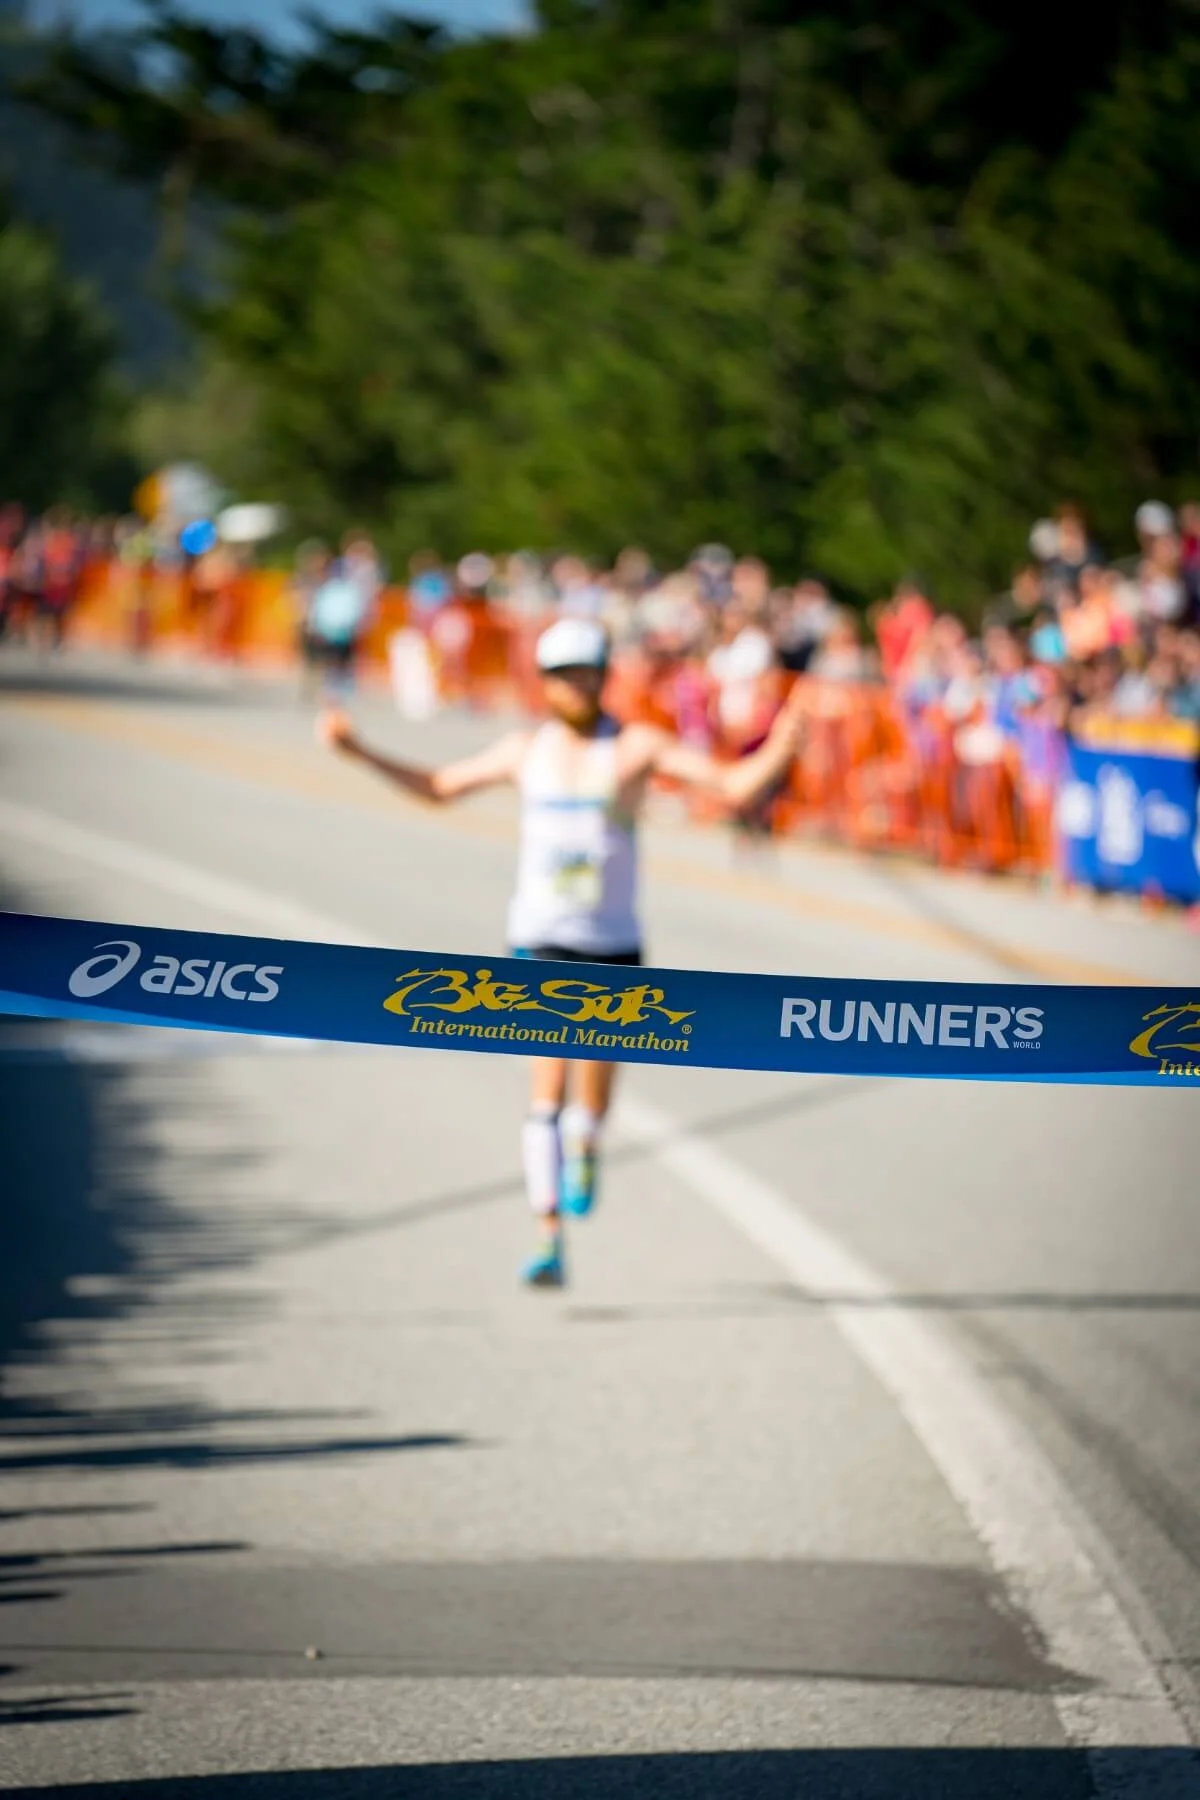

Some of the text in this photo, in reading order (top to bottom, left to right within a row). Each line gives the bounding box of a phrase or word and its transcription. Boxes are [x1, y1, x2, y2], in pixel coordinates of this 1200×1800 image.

[409, 1016, 569, 1044] International
[571, 1028, 690, 1052] Marathon
[779, 997, 1045, 1049] RUNNER'S
[1012, 1040, 1041, 1050] WORLD
